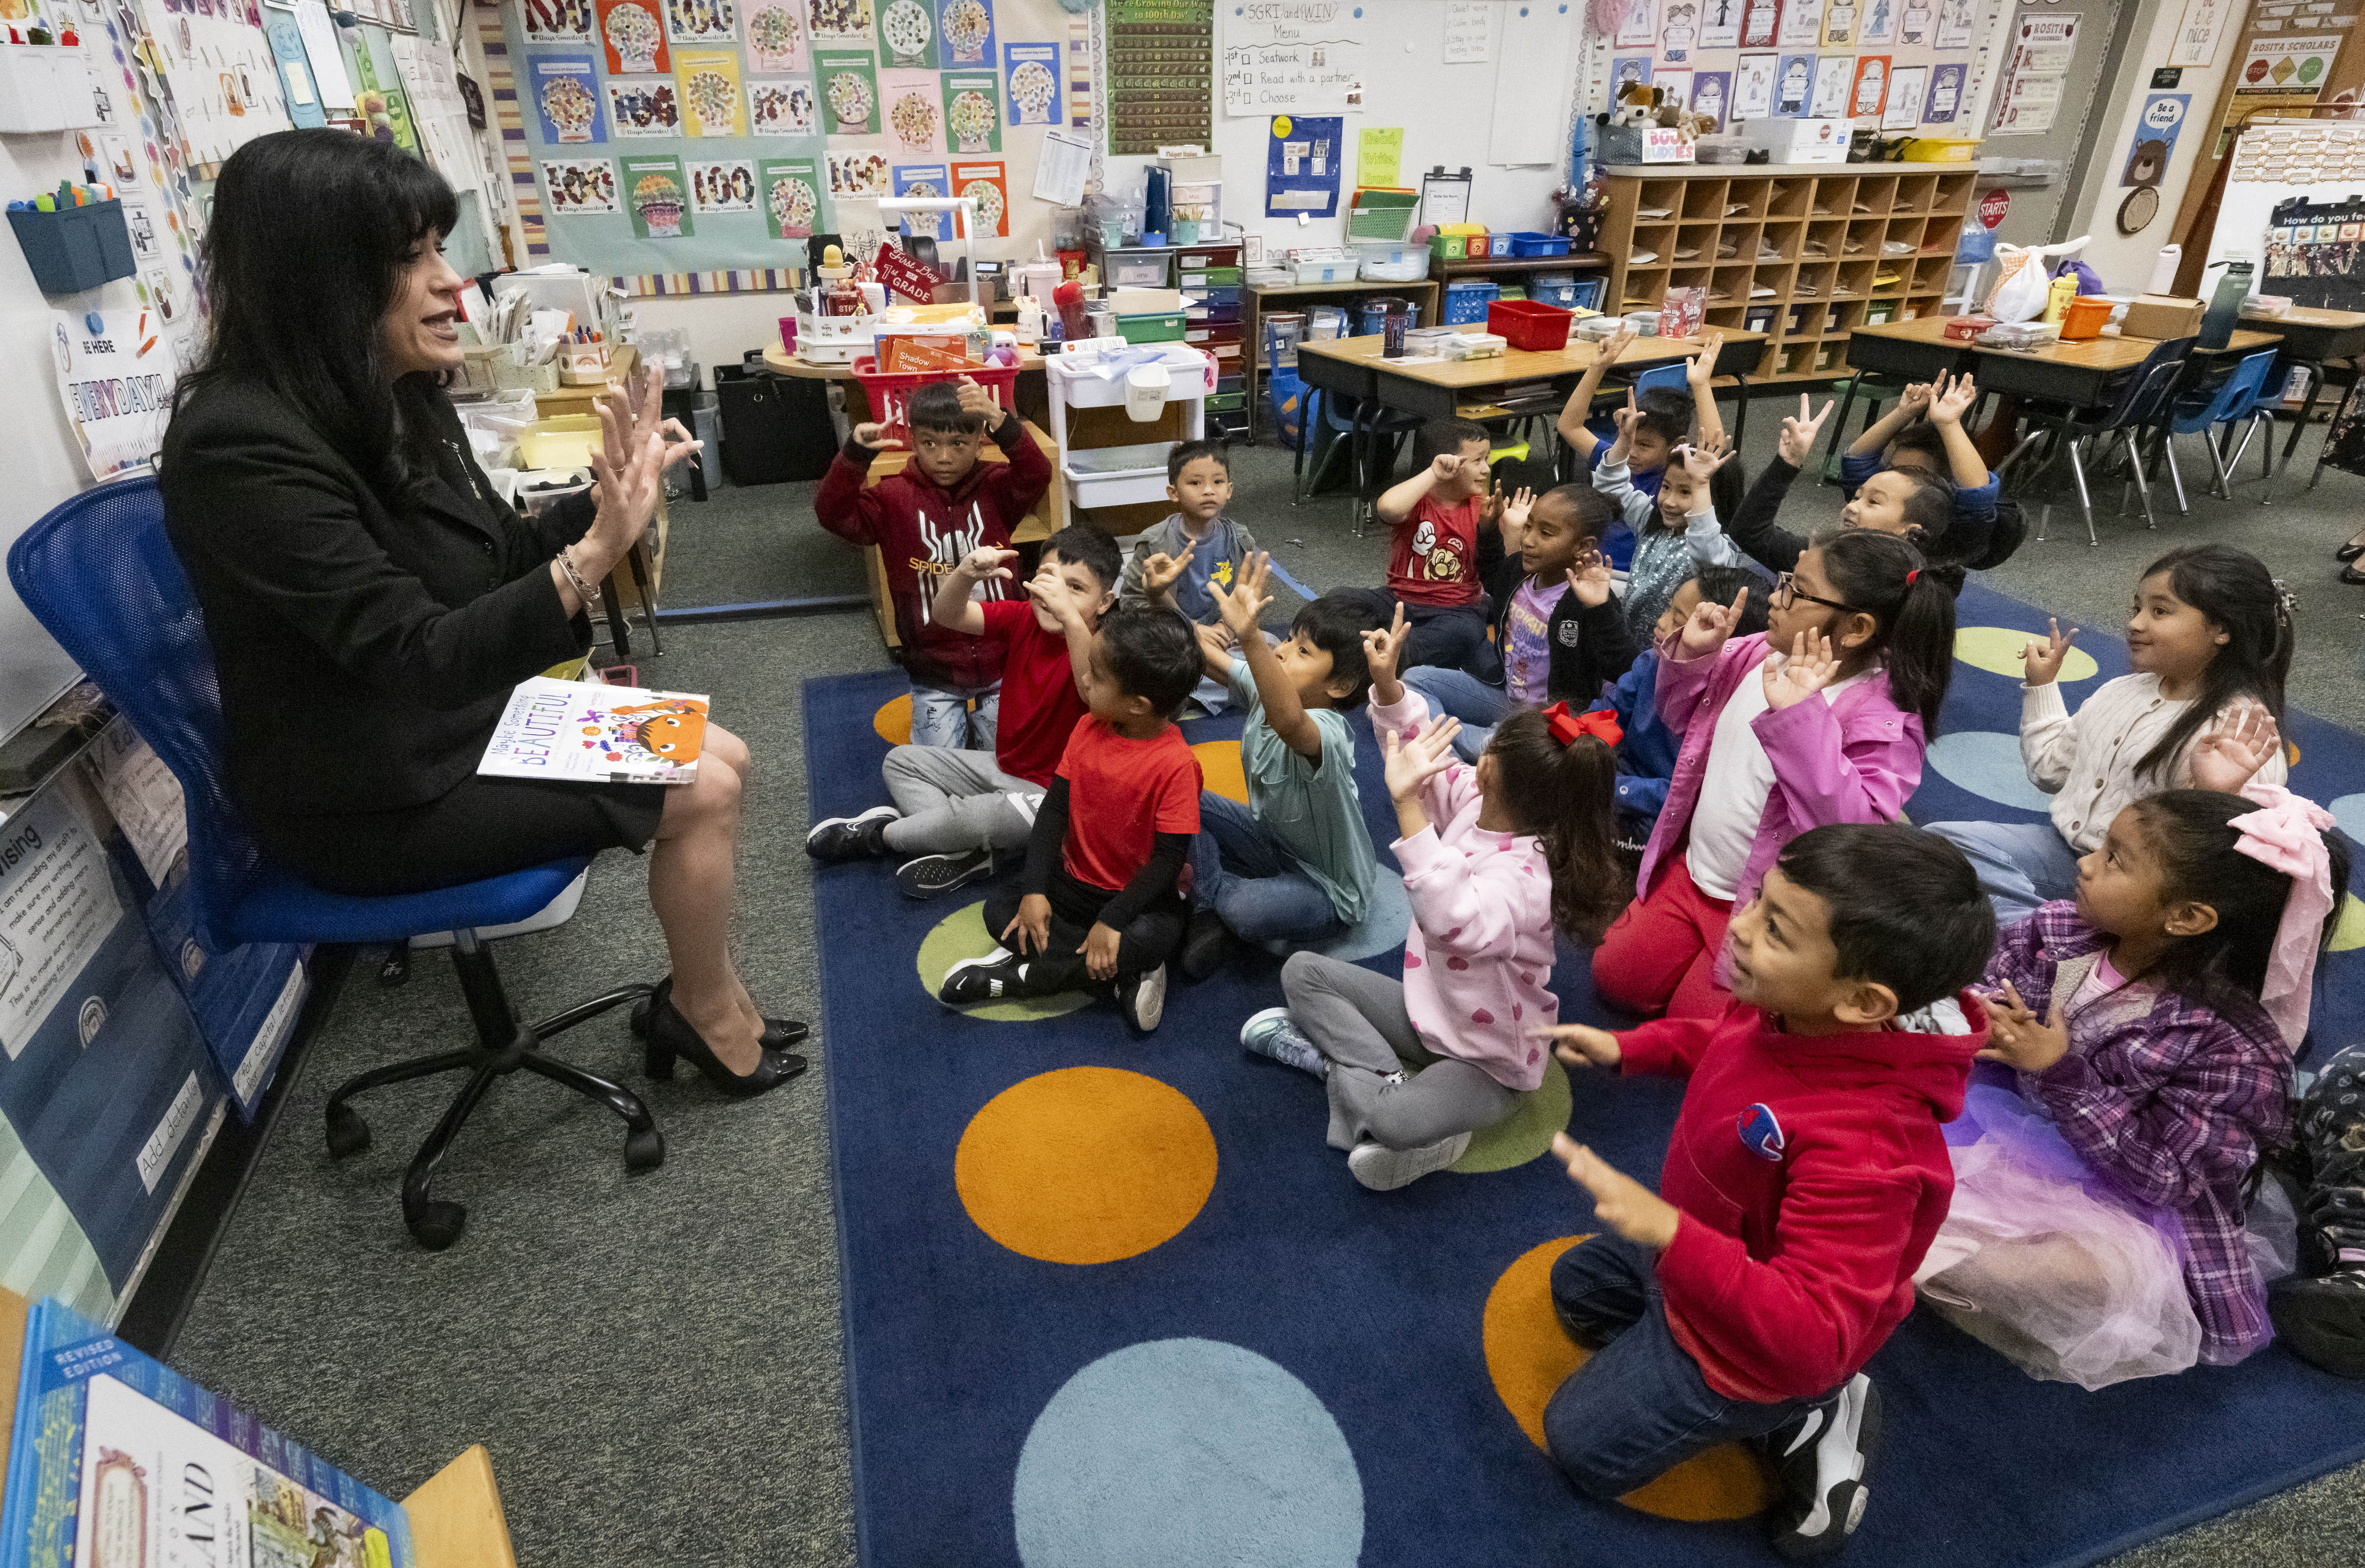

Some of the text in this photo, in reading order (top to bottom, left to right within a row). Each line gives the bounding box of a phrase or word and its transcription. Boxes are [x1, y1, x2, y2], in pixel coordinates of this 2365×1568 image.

[1136, 0, 1171, 9] Growing
[1191, 0, 1207, 8] Way
[1248, 4, 1331, 20] SGRI and WIN
[1452, 2, 1469, 12] Quiet
[1135, 9, 1188, 20] to 100th Day!
[1453, 15, 1486, 27] Calm body
[1274, 24, 1301, 39] Menu
[2033, 24, 2065, 34] ROSITA
[2186, 29, 2210, 43] nice
[682, 34, 698, 43] Days
[2253, 41, 2337, 52] ROSITA SCHOLARS
[1228, 51, 1300, 66] 1st Seatwork
[2023, 50, 2032, 66] R
[1227, 70, 1241, 86] 2nd
[1261, 72, 1284, 84] Read
[1290, 71, 1305, 83] with
[1321, 68, 1355, 87] partner
[2014, 79, 2025, 95] E
[1260, 90, 1297, 103] Choose
[2157, 103, 2167, 112] Be
[2150, 113, 2175, 123] friend.
[1365, 132, 1398, 147] Read,
[1363, 153, 1397, 167] Write,
[1365, 173, 1394, 186] Erase
[1981, 201, 2008, 217] STARTS
[2284, 216, 2308, 226] How
[2311, 215, 2325, 224] do
[2328, 215, 2349, 225] you
[882, 264, 899, 280] 1st
[889, 248, 939, 284] First Day
[892, 277, 931, 302] GRADE
[83, 340, 116, 355] BE HERE
[898, 361, 918, 372] Town
[899, 352, 930, 367] Shadow
[908, 556, 956, 576] SPIDE
[490, 695, 536, 755] Maybe Something
[510, 693, 572, 766] BEAUTIFUL
[4, 895, 16, 908] am
[14, 861, 48, 897] re-reading
[46, 850, 57, 863] my
[56, 832, 70, 853] draft
[9, 909, 27, 930] make
[27, 893, 41, 911] sure
[41, 882, 51, 895] my
[51, 860, 72, 883] writing
[28, 864, 89, 935] sense and adding more
[42, 907, 72, 944] interesting
[9, 992, 24, 1008] This
[24, 984, 31, 993] is
[30, 975, 38, 985] to
[37, 955, 53, 976] make
[254, 1013, 277, 1057] capital
[141, 1079, 200, 1176] Add details
[54, 1339, 116, 1366] REVISED
[63, 1349, 123, 1380] EDITION
